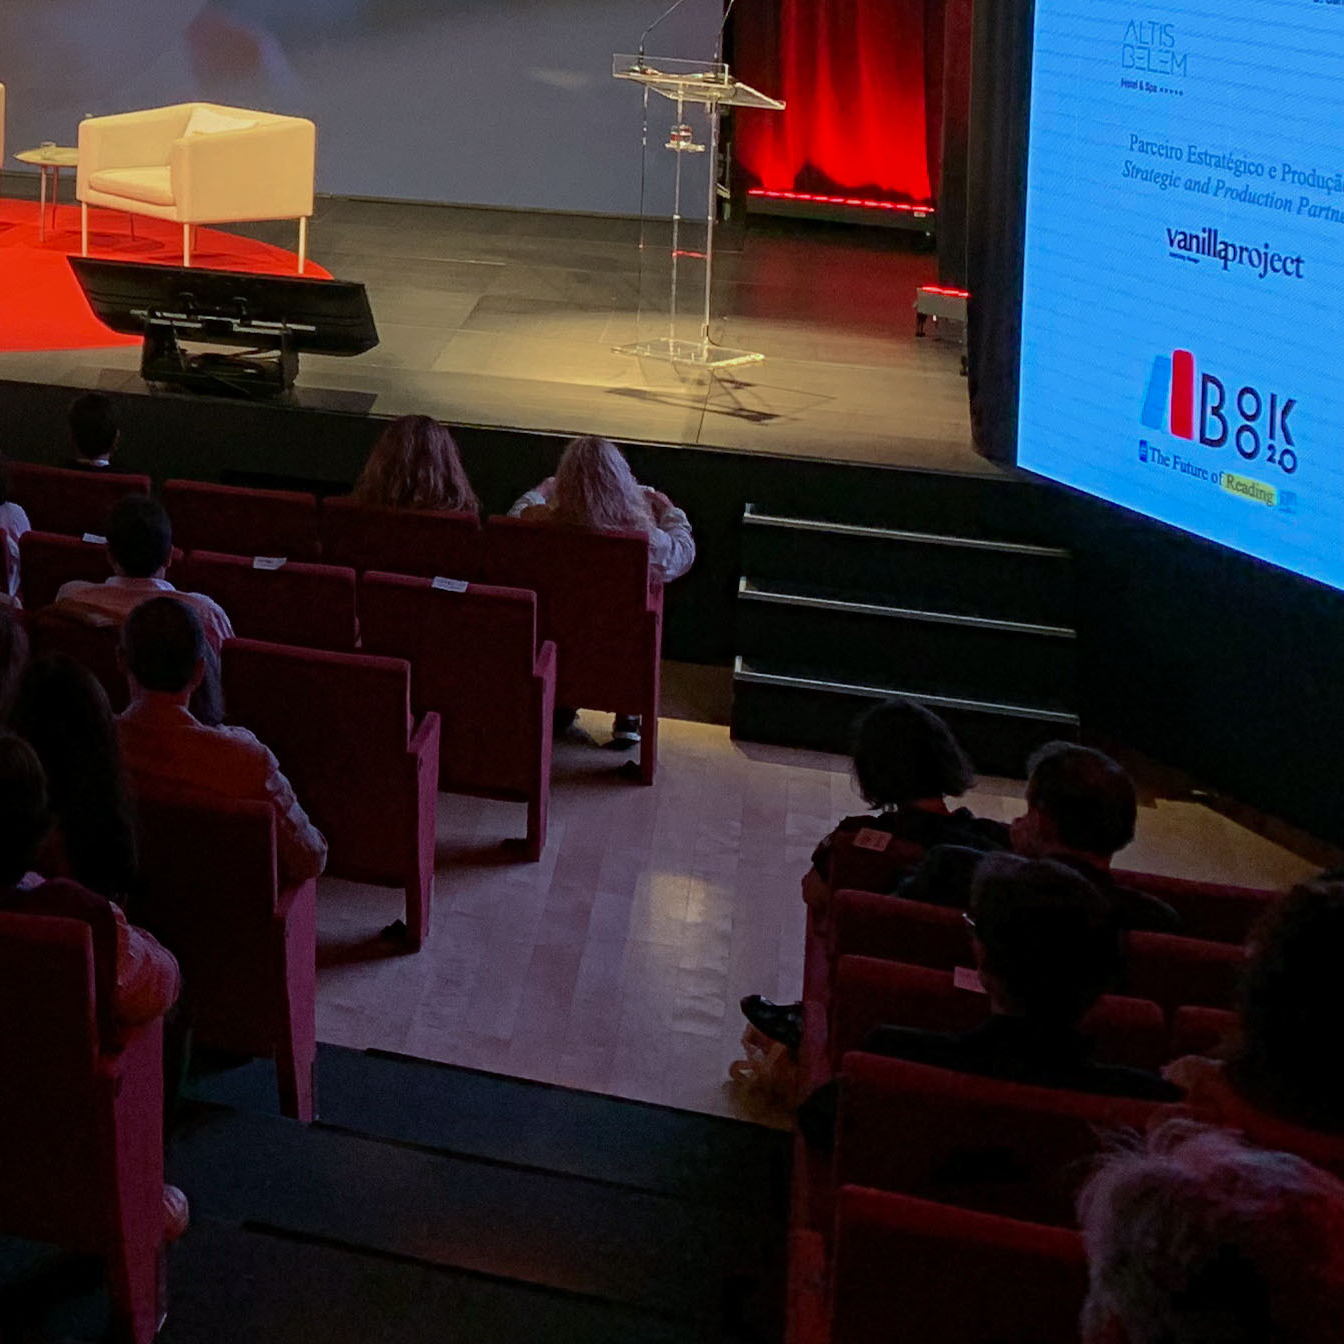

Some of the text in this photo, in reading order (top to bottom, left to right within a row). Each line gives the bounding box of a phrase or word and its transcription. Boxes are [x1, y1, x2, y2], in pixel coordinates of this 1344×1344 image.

[1123, 19, 1176, 48] ALTIS
[1122, 159, 1181, 191] Strategic
[1184, 176, 1211, 194] and
[1213, 179, 1292, 212] Production
[1129, 133, 1344, 195] Parceiro Estratégico e Produçã
[1167, 227, 1305, 279] vanillaproject
[1173, 456, 1209, 480] Future
[1211, 471, 1224, 486] of
[1226, 474, 1274, 506] Reading
